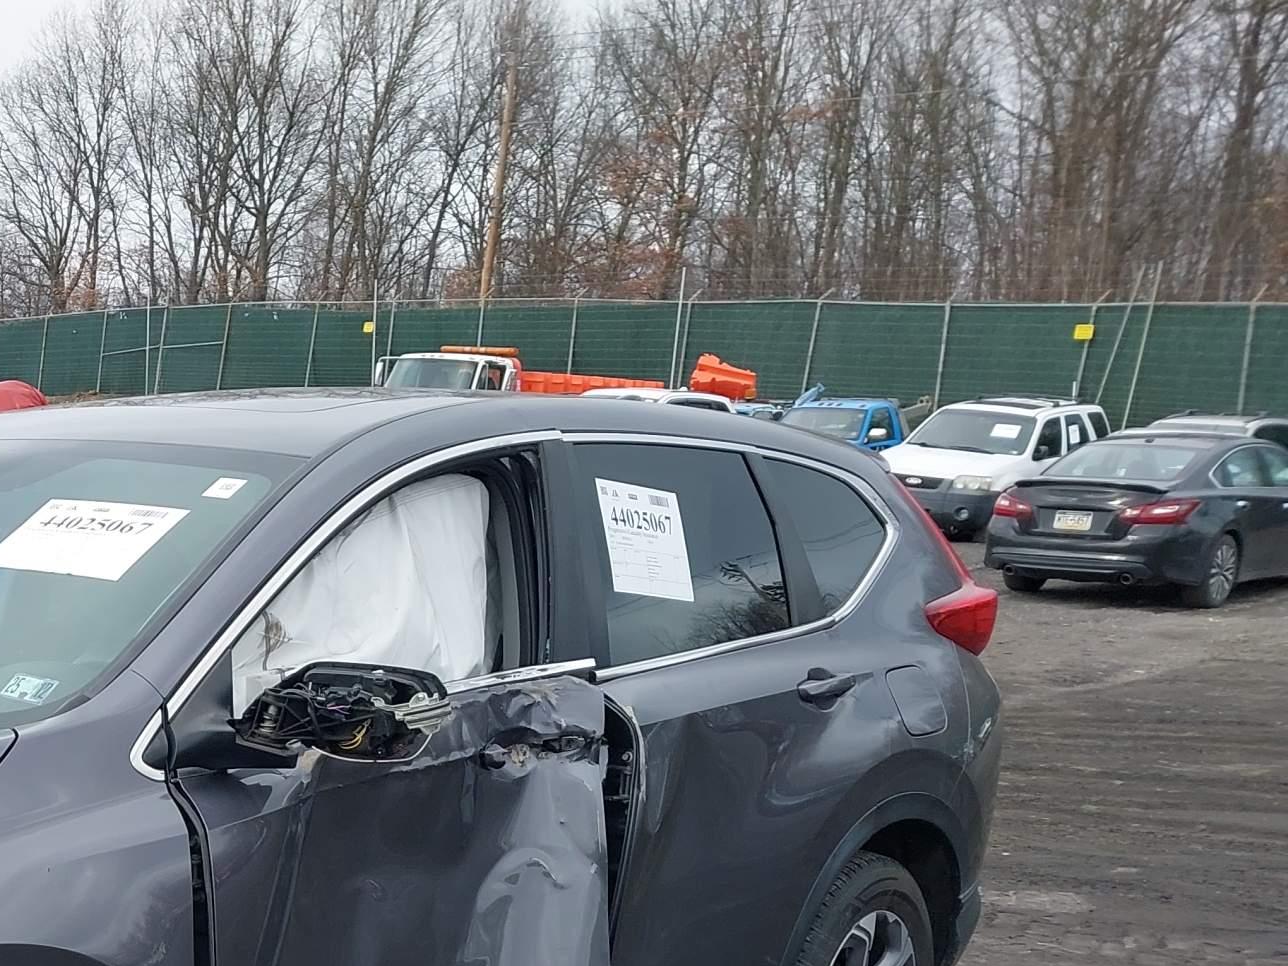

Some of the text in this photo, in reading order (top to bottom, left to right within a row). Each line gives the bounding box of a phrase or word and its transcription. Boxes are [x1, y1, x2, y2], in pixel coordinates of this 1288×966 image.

[40, 515, 154, 534] 44025067
[611, 506, 671, 535] 44025067
[5, 676, 26, 694] 25
